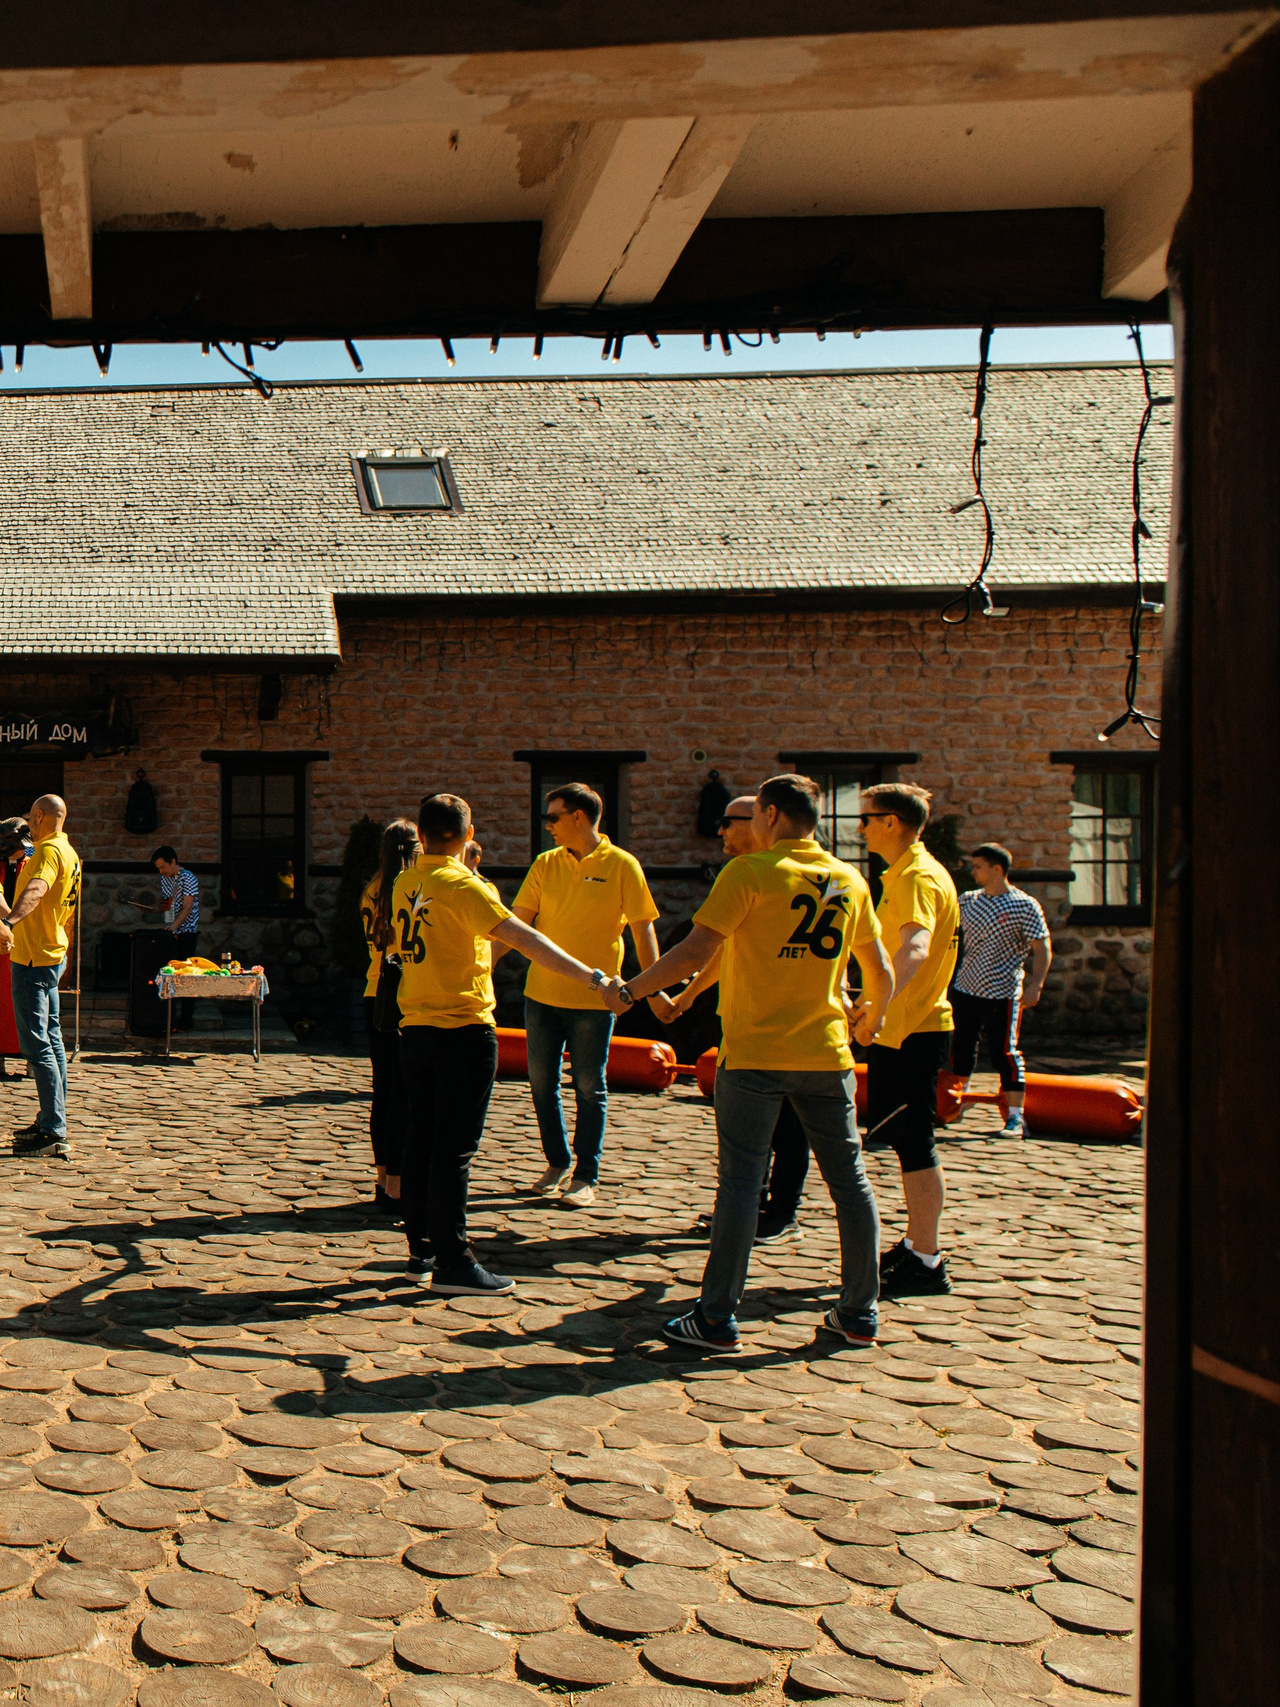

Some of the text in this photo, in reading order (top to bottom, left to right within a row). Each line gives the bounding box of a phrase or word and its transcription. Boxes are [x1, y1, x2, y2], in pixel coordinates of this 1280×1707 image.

[49, 723, 87, 743] ДОМ
[397, 908, 426, 964] 26
[787, 893, 843, 960] 26
[777, 946, 807, 958] ЛЕТ
